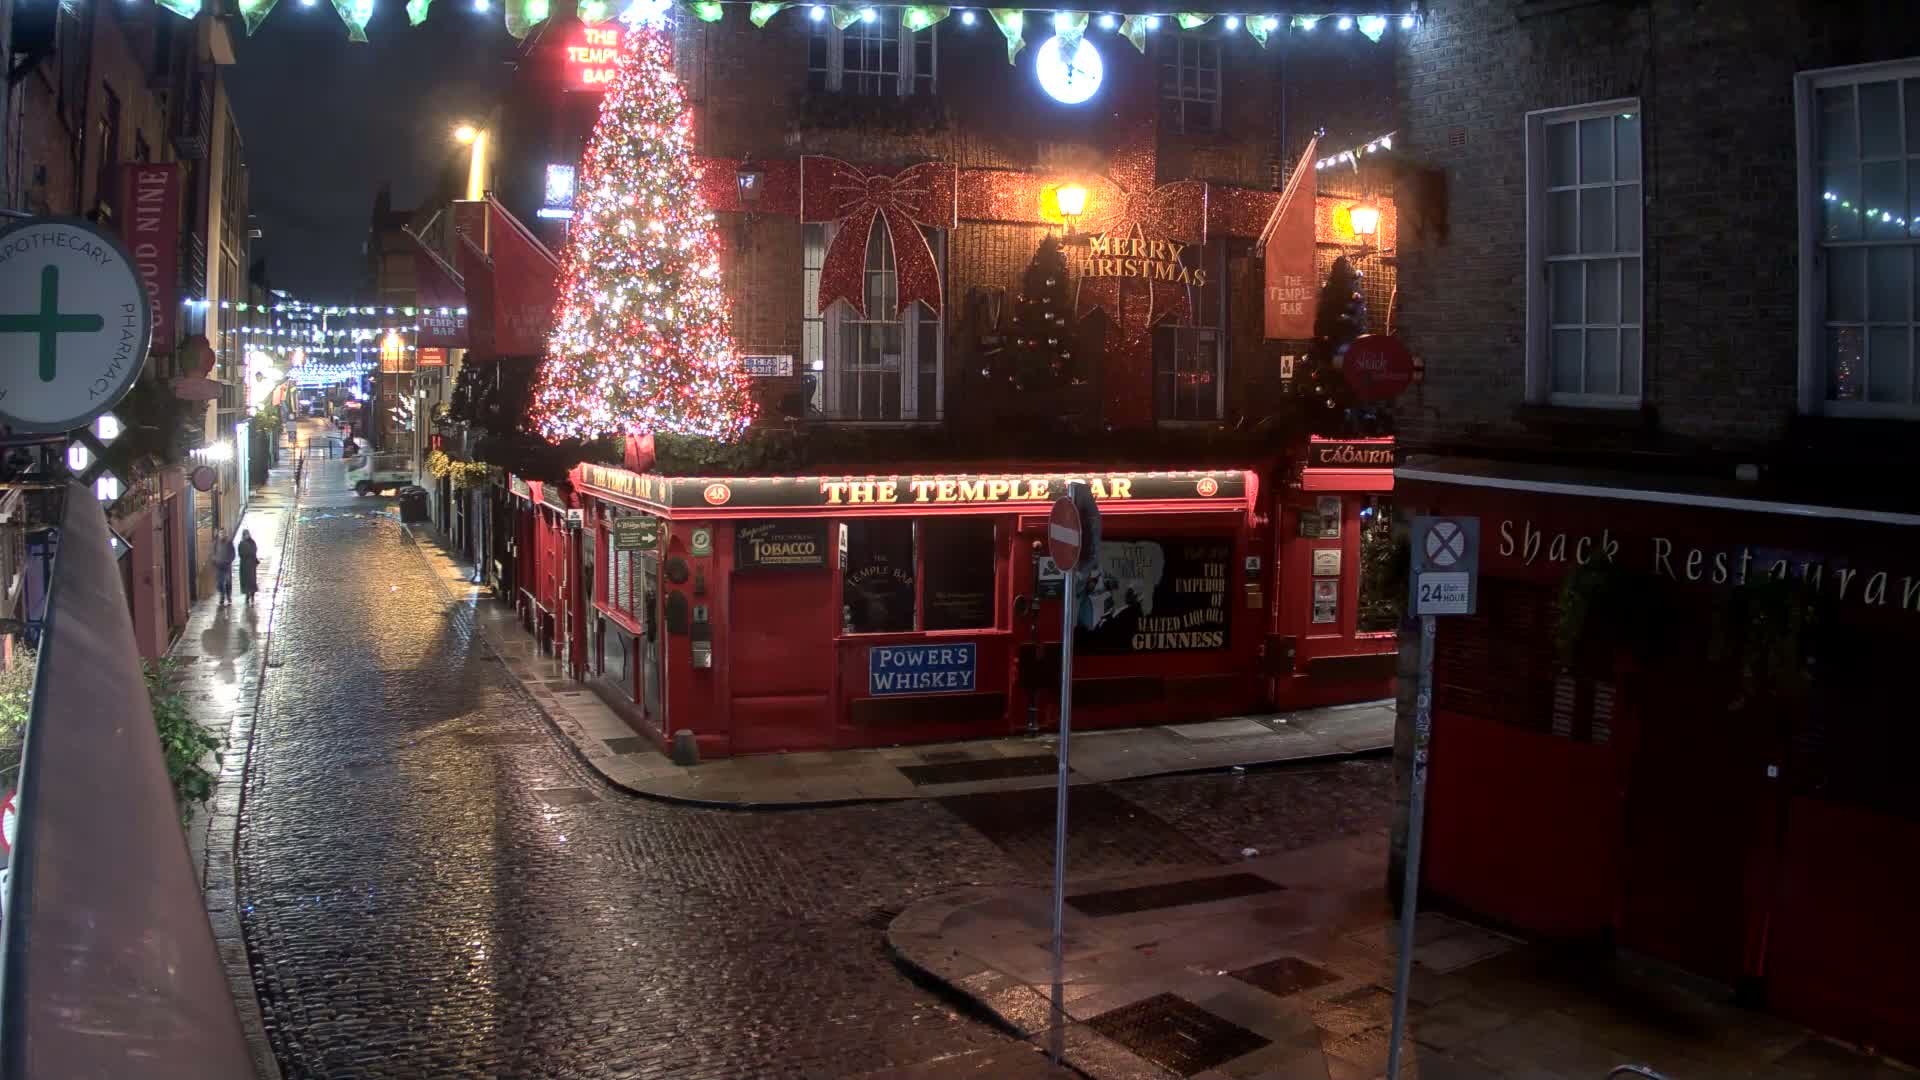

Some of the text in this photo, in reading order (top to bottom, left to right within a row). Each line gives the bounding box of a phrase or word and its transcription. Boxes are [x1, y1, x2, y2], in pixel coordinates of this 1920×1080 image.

[584, 28, 617, 46] THE
[136, 171, 168, 232] NINE
[1089, 237, 1186, 262] MERRY
[1079, 258, 1207, 287] HRISTMAS
[1282, 275, 1304, 287] THE
[1280, 302, 1304, 315] BAR
[433, 327, 456, 336] BAR
[89, 304, 136, 400] PHARMACY
[593, 466, 607, 488] THE
[607, 468, 634, 495] TEMPLE
[635, 476, 651, 499] BAR
[822, 477, 1132, 503] THE TEMPLE AR
[709, 486, 725, 499] 48
[750, 538, 816, 561] TOBACCO
[1203, 562, 1225, 577] THE
[1210, 593, 1225, 608] OF
[1421, 584, 1442, 602] 24
[1131, 631, 1225, 650] GUINNESS
[879, 648, 968, 668] POWER'S
[872, 670, 973, 690] WHISKEY
